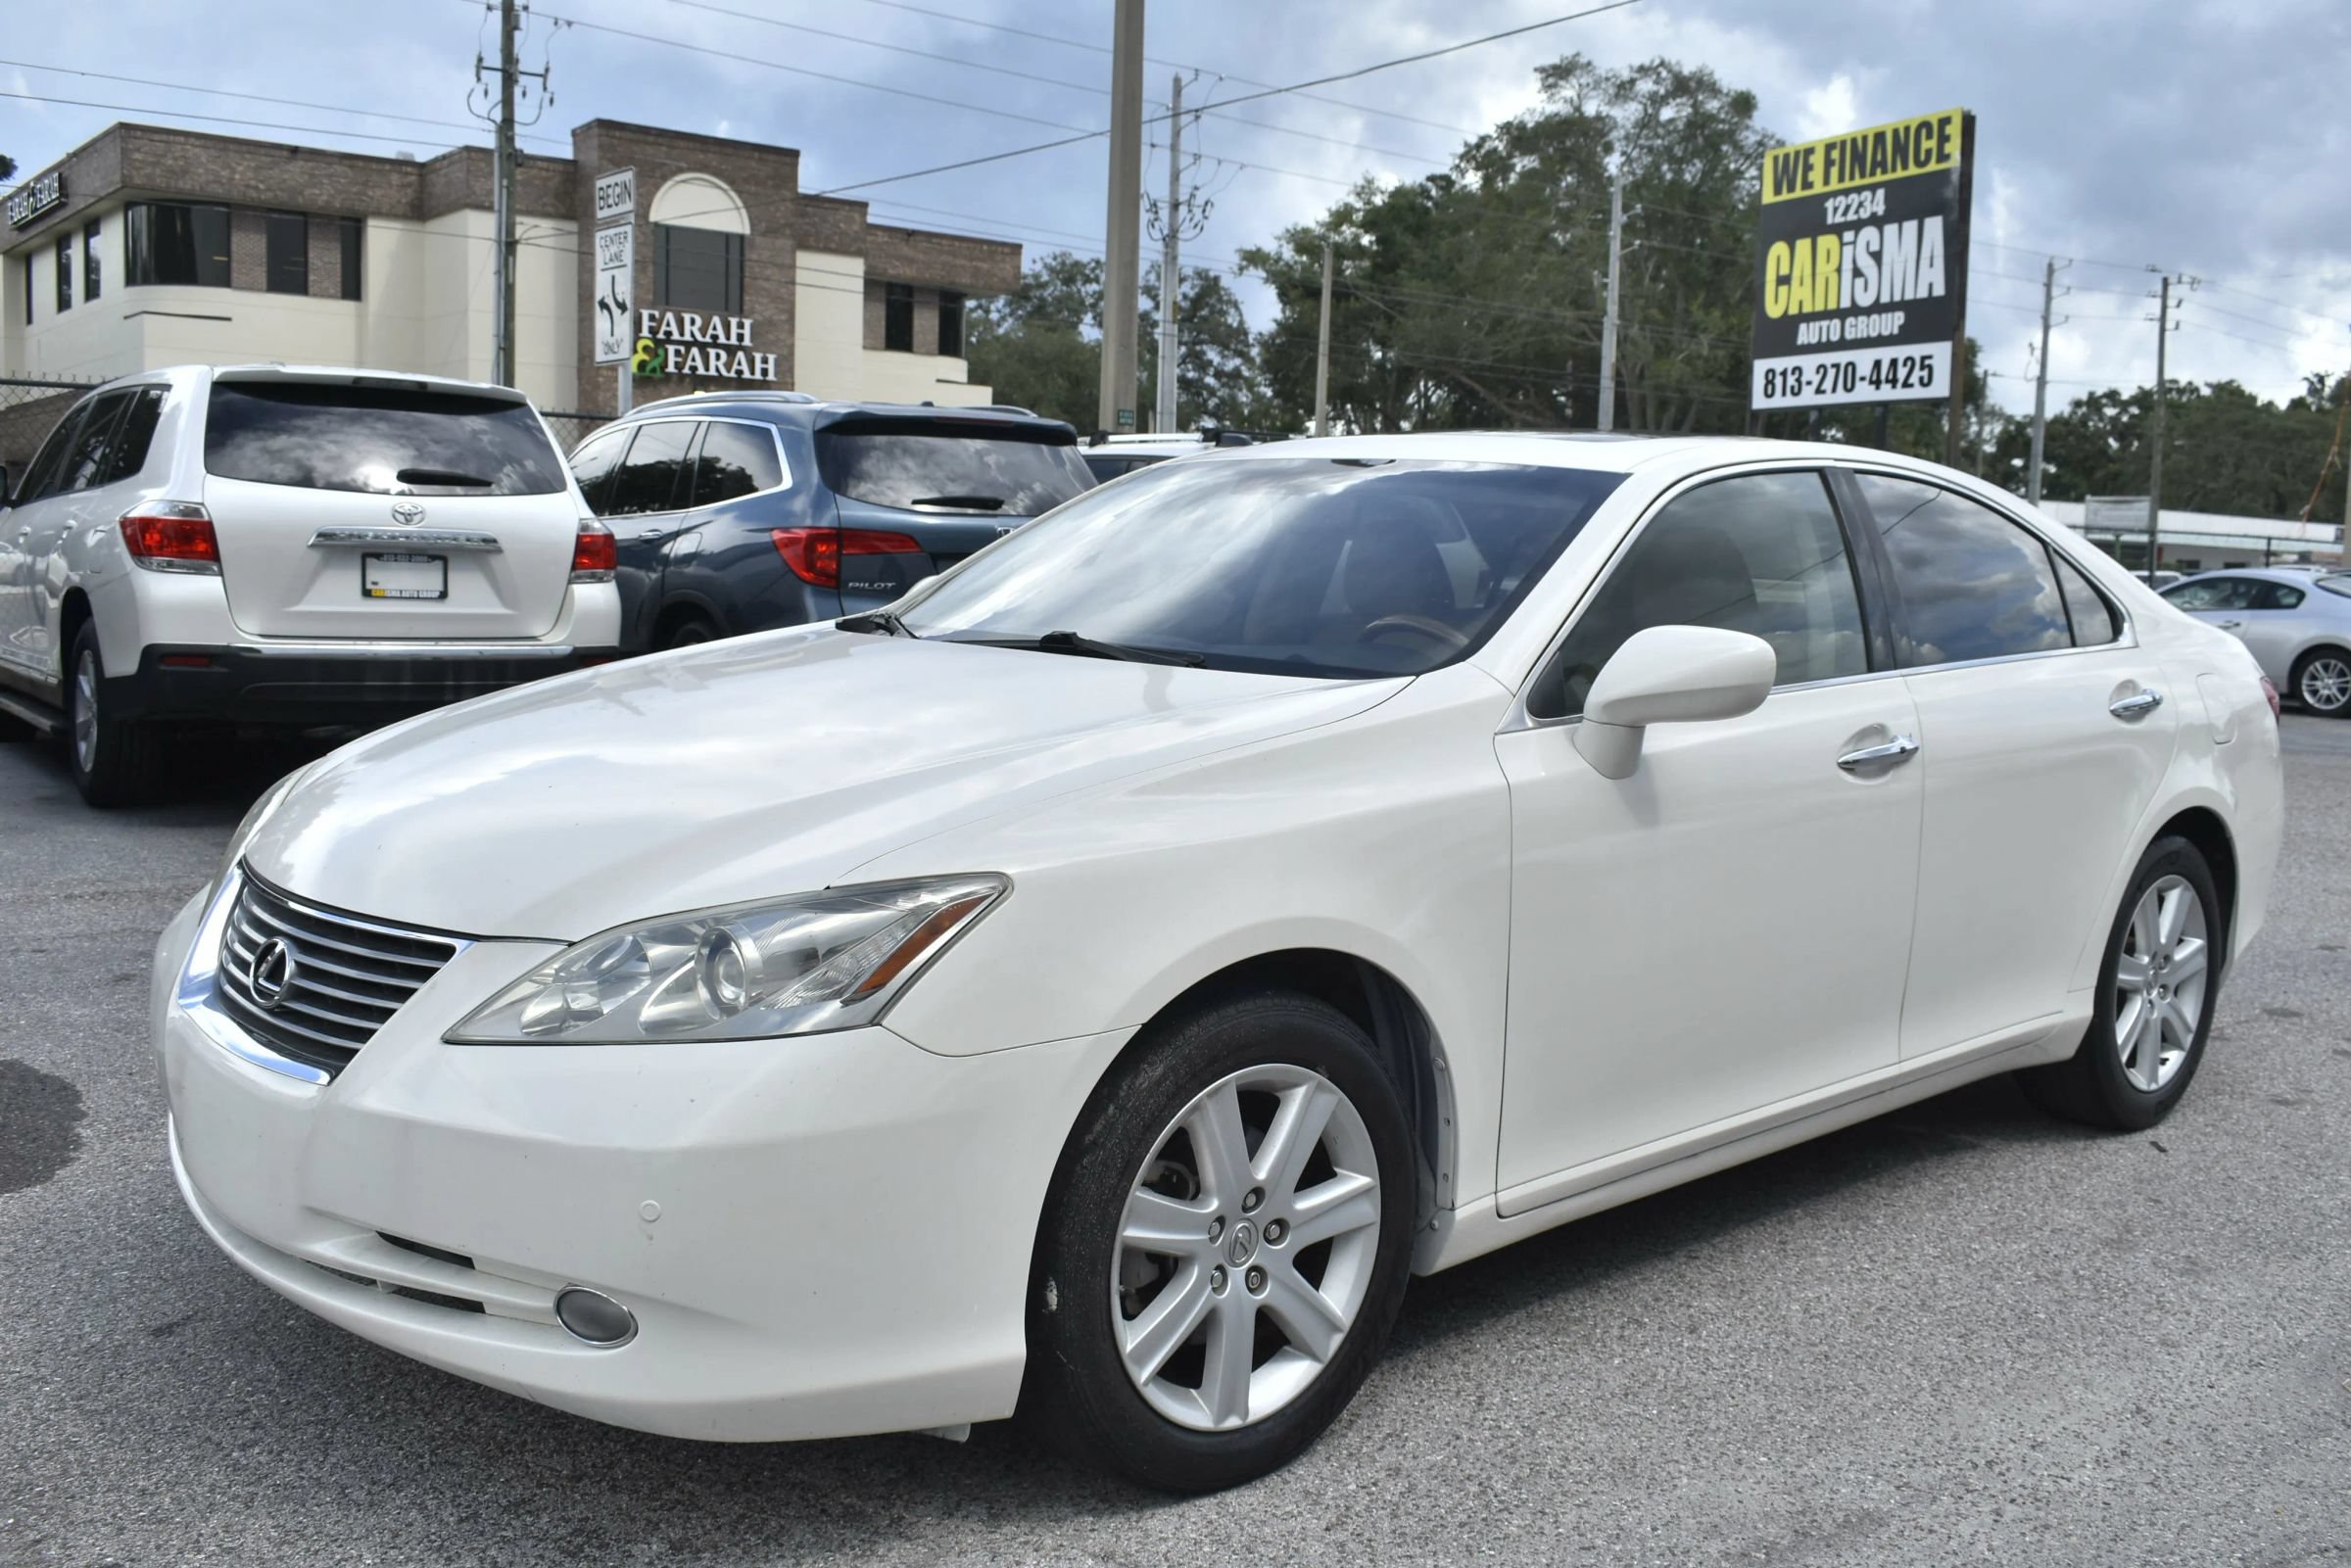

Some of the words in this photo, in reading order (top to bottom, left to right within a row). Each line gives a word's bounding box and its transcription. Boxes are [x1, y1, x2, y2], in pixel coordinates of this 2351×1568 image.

[1772, 148, 1815, 197] WE
[1823, 116, 1952, 187] FINANCE
[598, 177, 633, 212] BEGIN
[1824, 187, 1886, 225] 12234
[600, 230, 629, 249] CENTER
[602, 249, 625, 266] LANE
[639, 309, 753, 348] FARAH
[1797, 318, 1841, 346] AUTO
[1844, 310, 1905, 341] GROUP
[664, 344, 778, 382] FARAH
[1763, 355, 1934, 400] 813-270-4425
